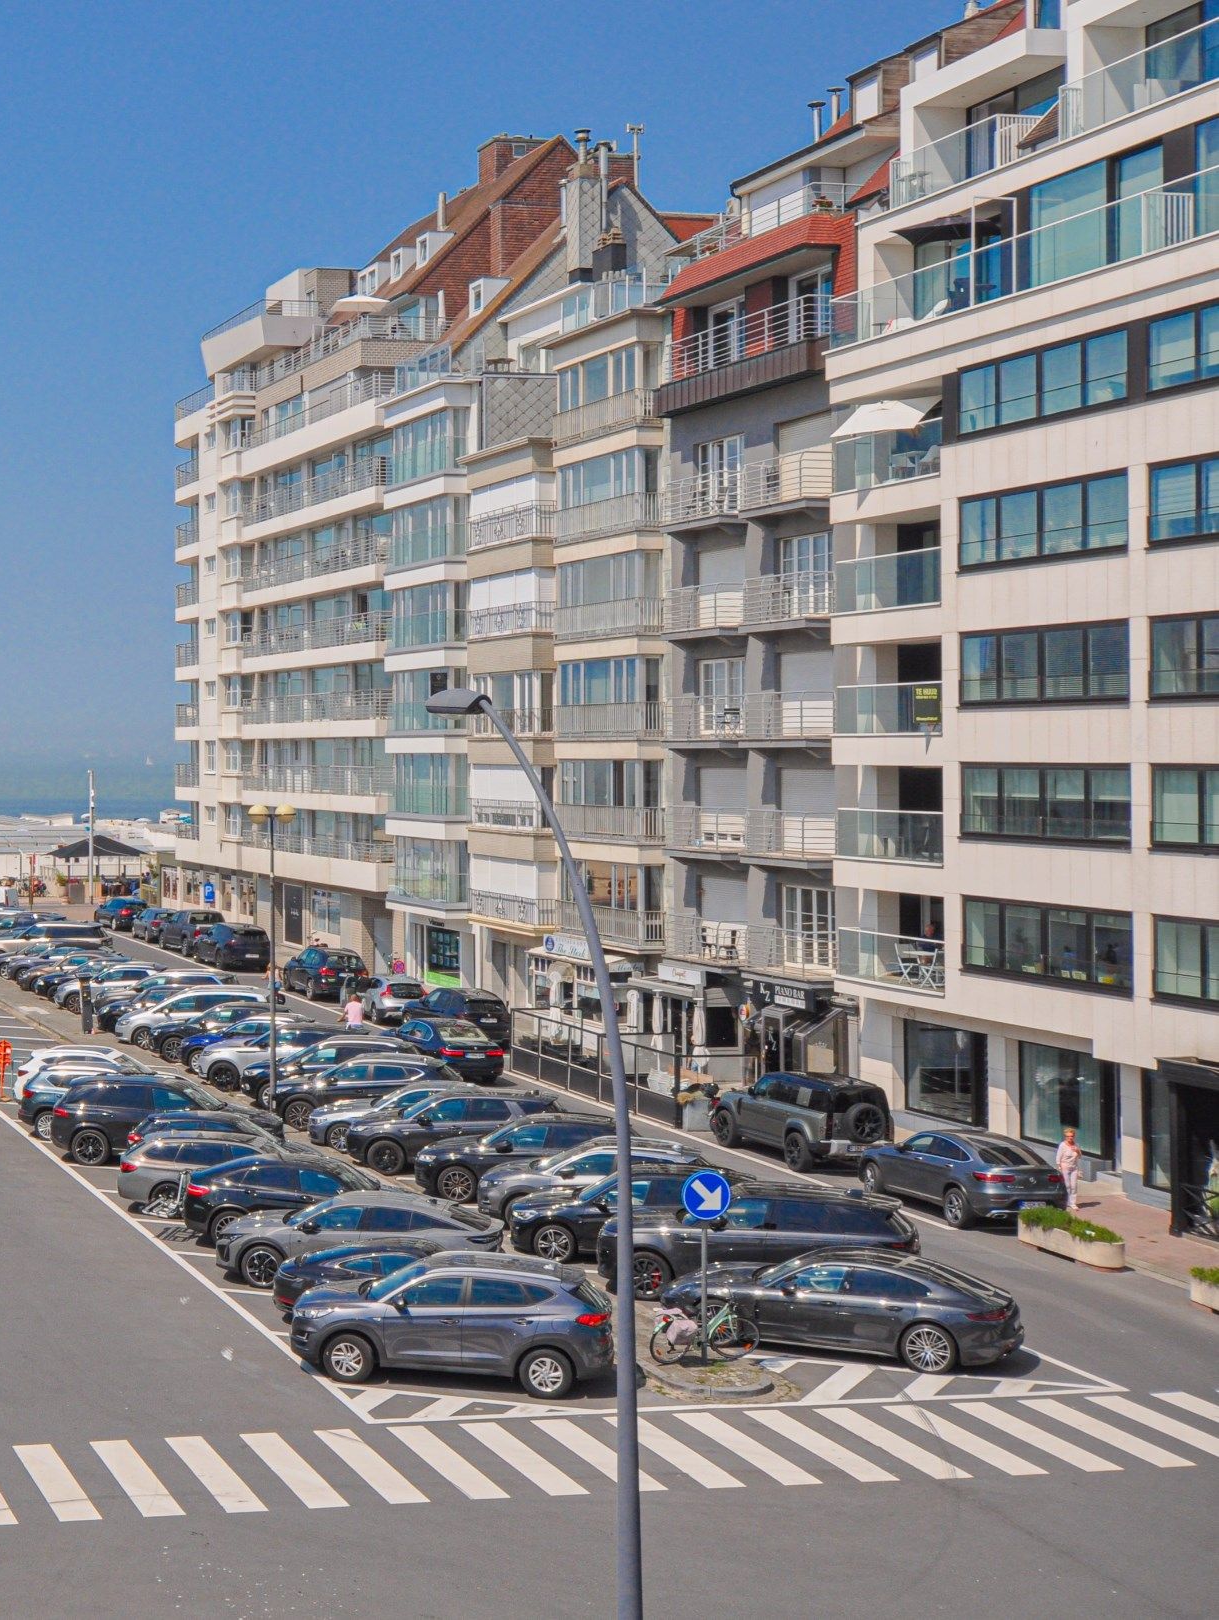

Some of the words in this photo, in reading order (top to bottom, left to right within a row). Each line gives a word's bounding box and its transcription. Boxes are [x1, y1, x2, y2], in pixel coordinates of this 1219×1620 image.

[205, 885, 212, 897] P
[775, 986, 792, 997] PIANO
[793, 989, 805, 999] BAR
